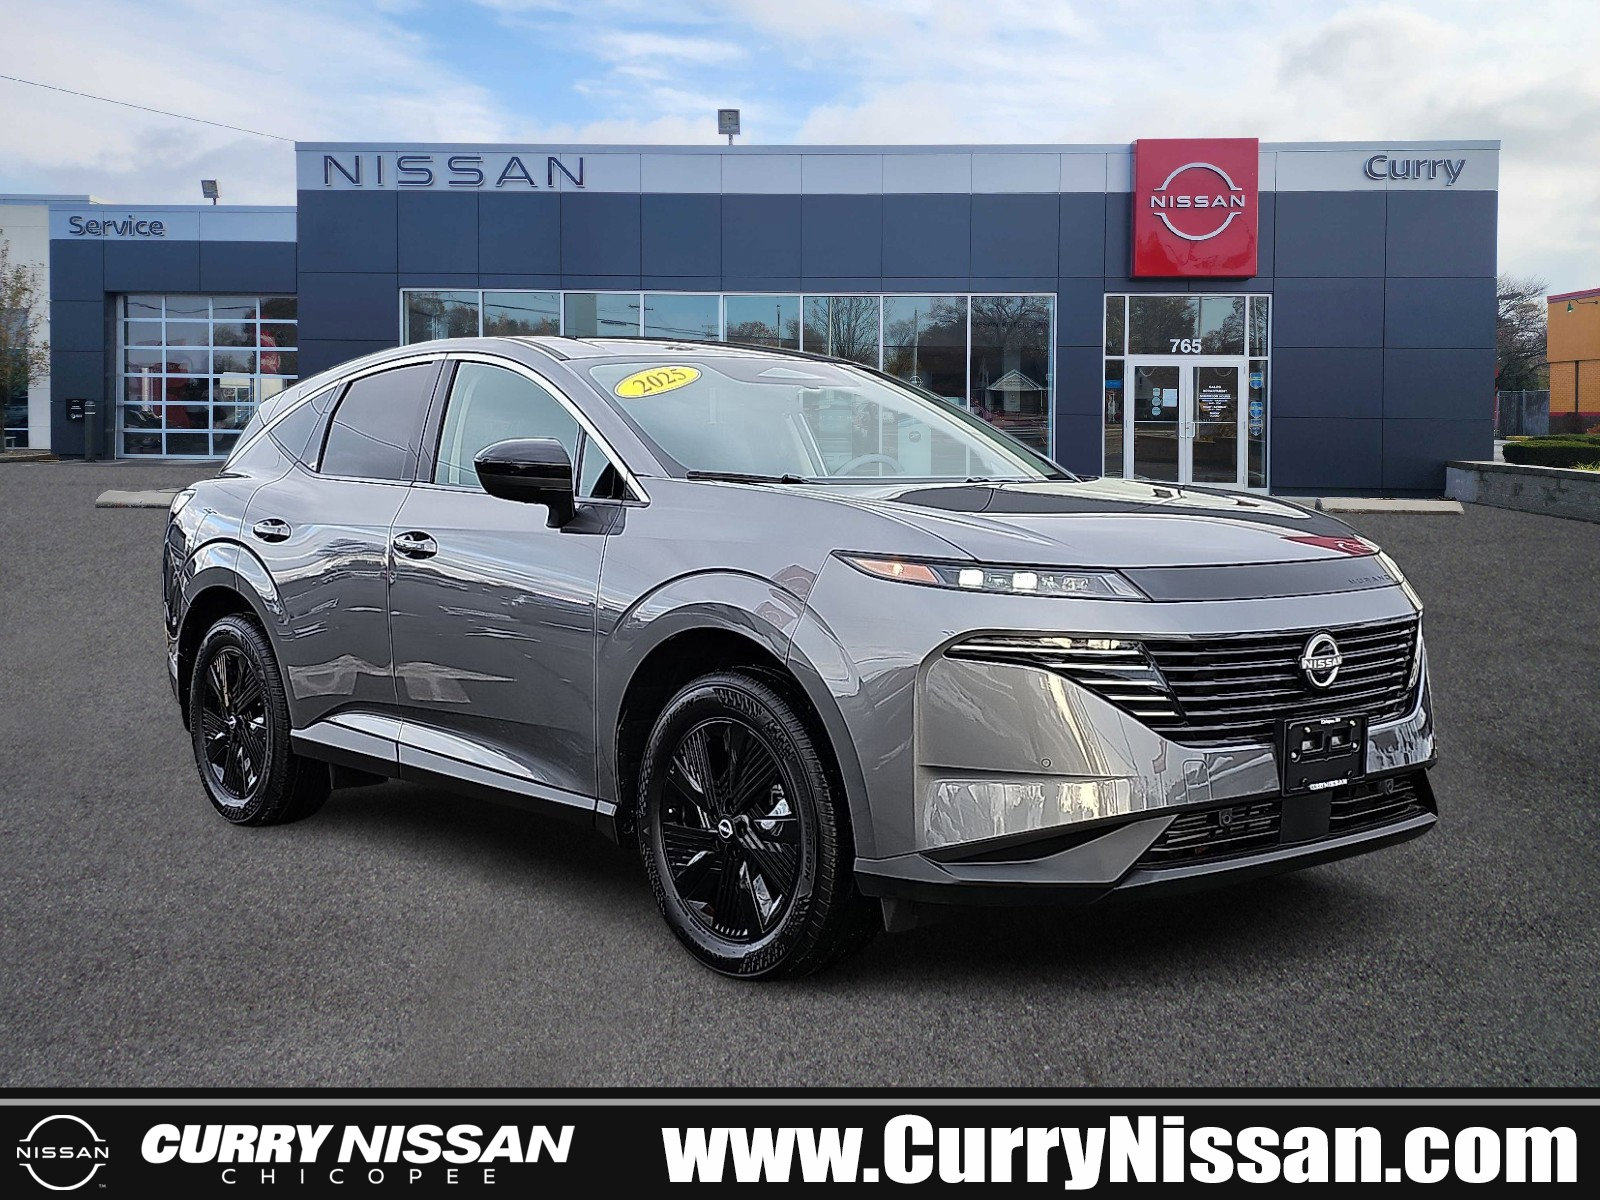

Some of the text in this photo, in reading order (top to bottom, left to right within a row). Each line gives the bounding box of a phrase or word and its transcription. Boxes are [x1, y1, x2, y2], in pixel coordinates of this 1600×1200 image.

[323, 154, 586, 189] NISSAN
[1364, 153, 1466, 186] Curry
[1150, 194, 1246, 208] NISSAN
[68, 213, 165, 238] Service
[1169, 338, 1202, 354] 765
[632, 368, 687, 393] 2025
[1302, 655, 1343, 670] NISSAN
